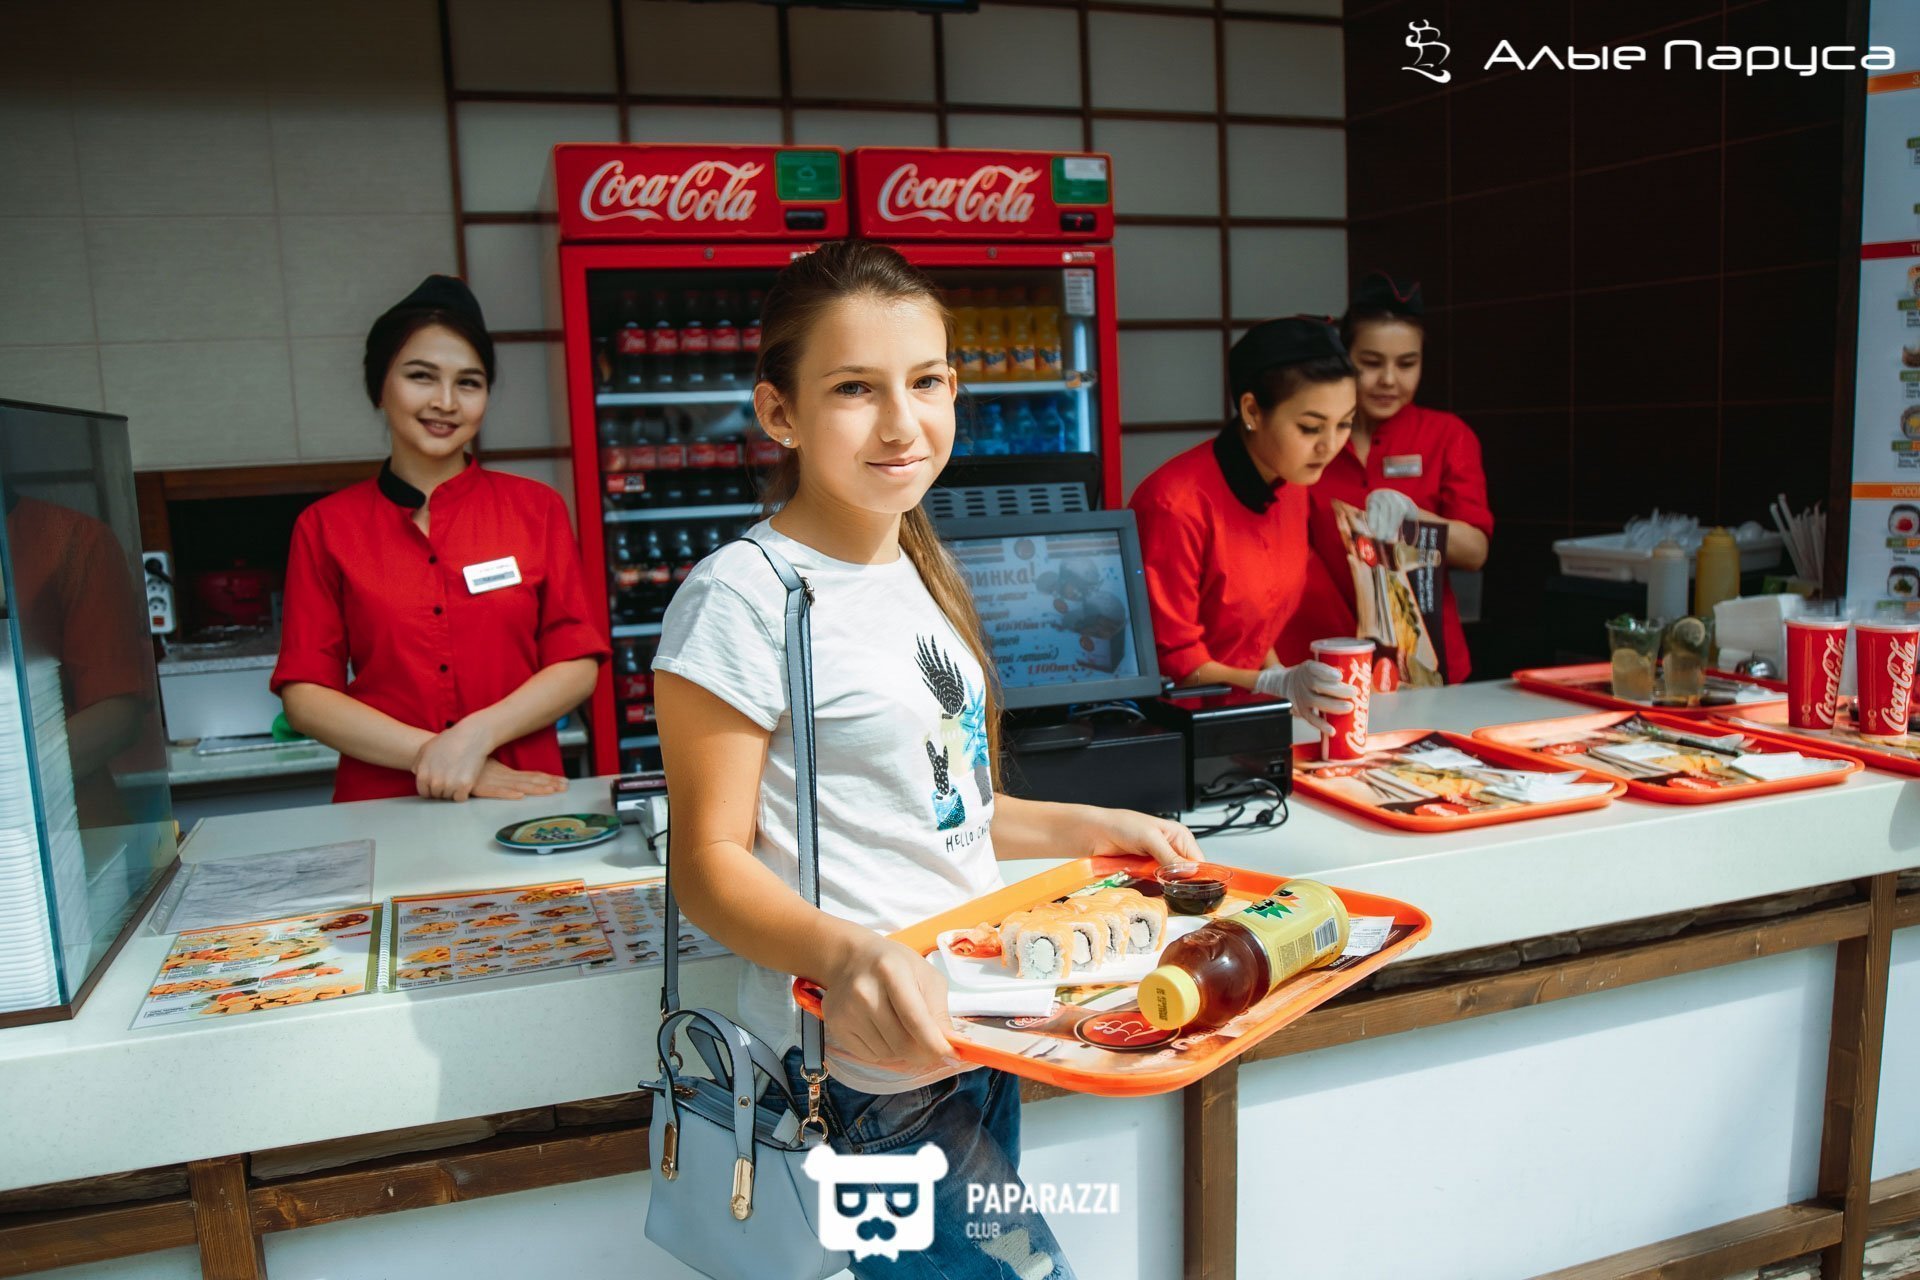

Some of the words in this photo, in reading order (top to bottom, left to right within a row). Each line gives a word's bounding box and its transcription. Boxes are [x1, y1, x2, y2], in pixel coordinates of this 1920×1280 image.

[580, 160, 764, 222] Coca-Cola
[877, 162, 1043, 223] Coca-Cola
[1881, 636, 1917, 733] Coca-Cola
[945, 831, 974, 853] HELLO
